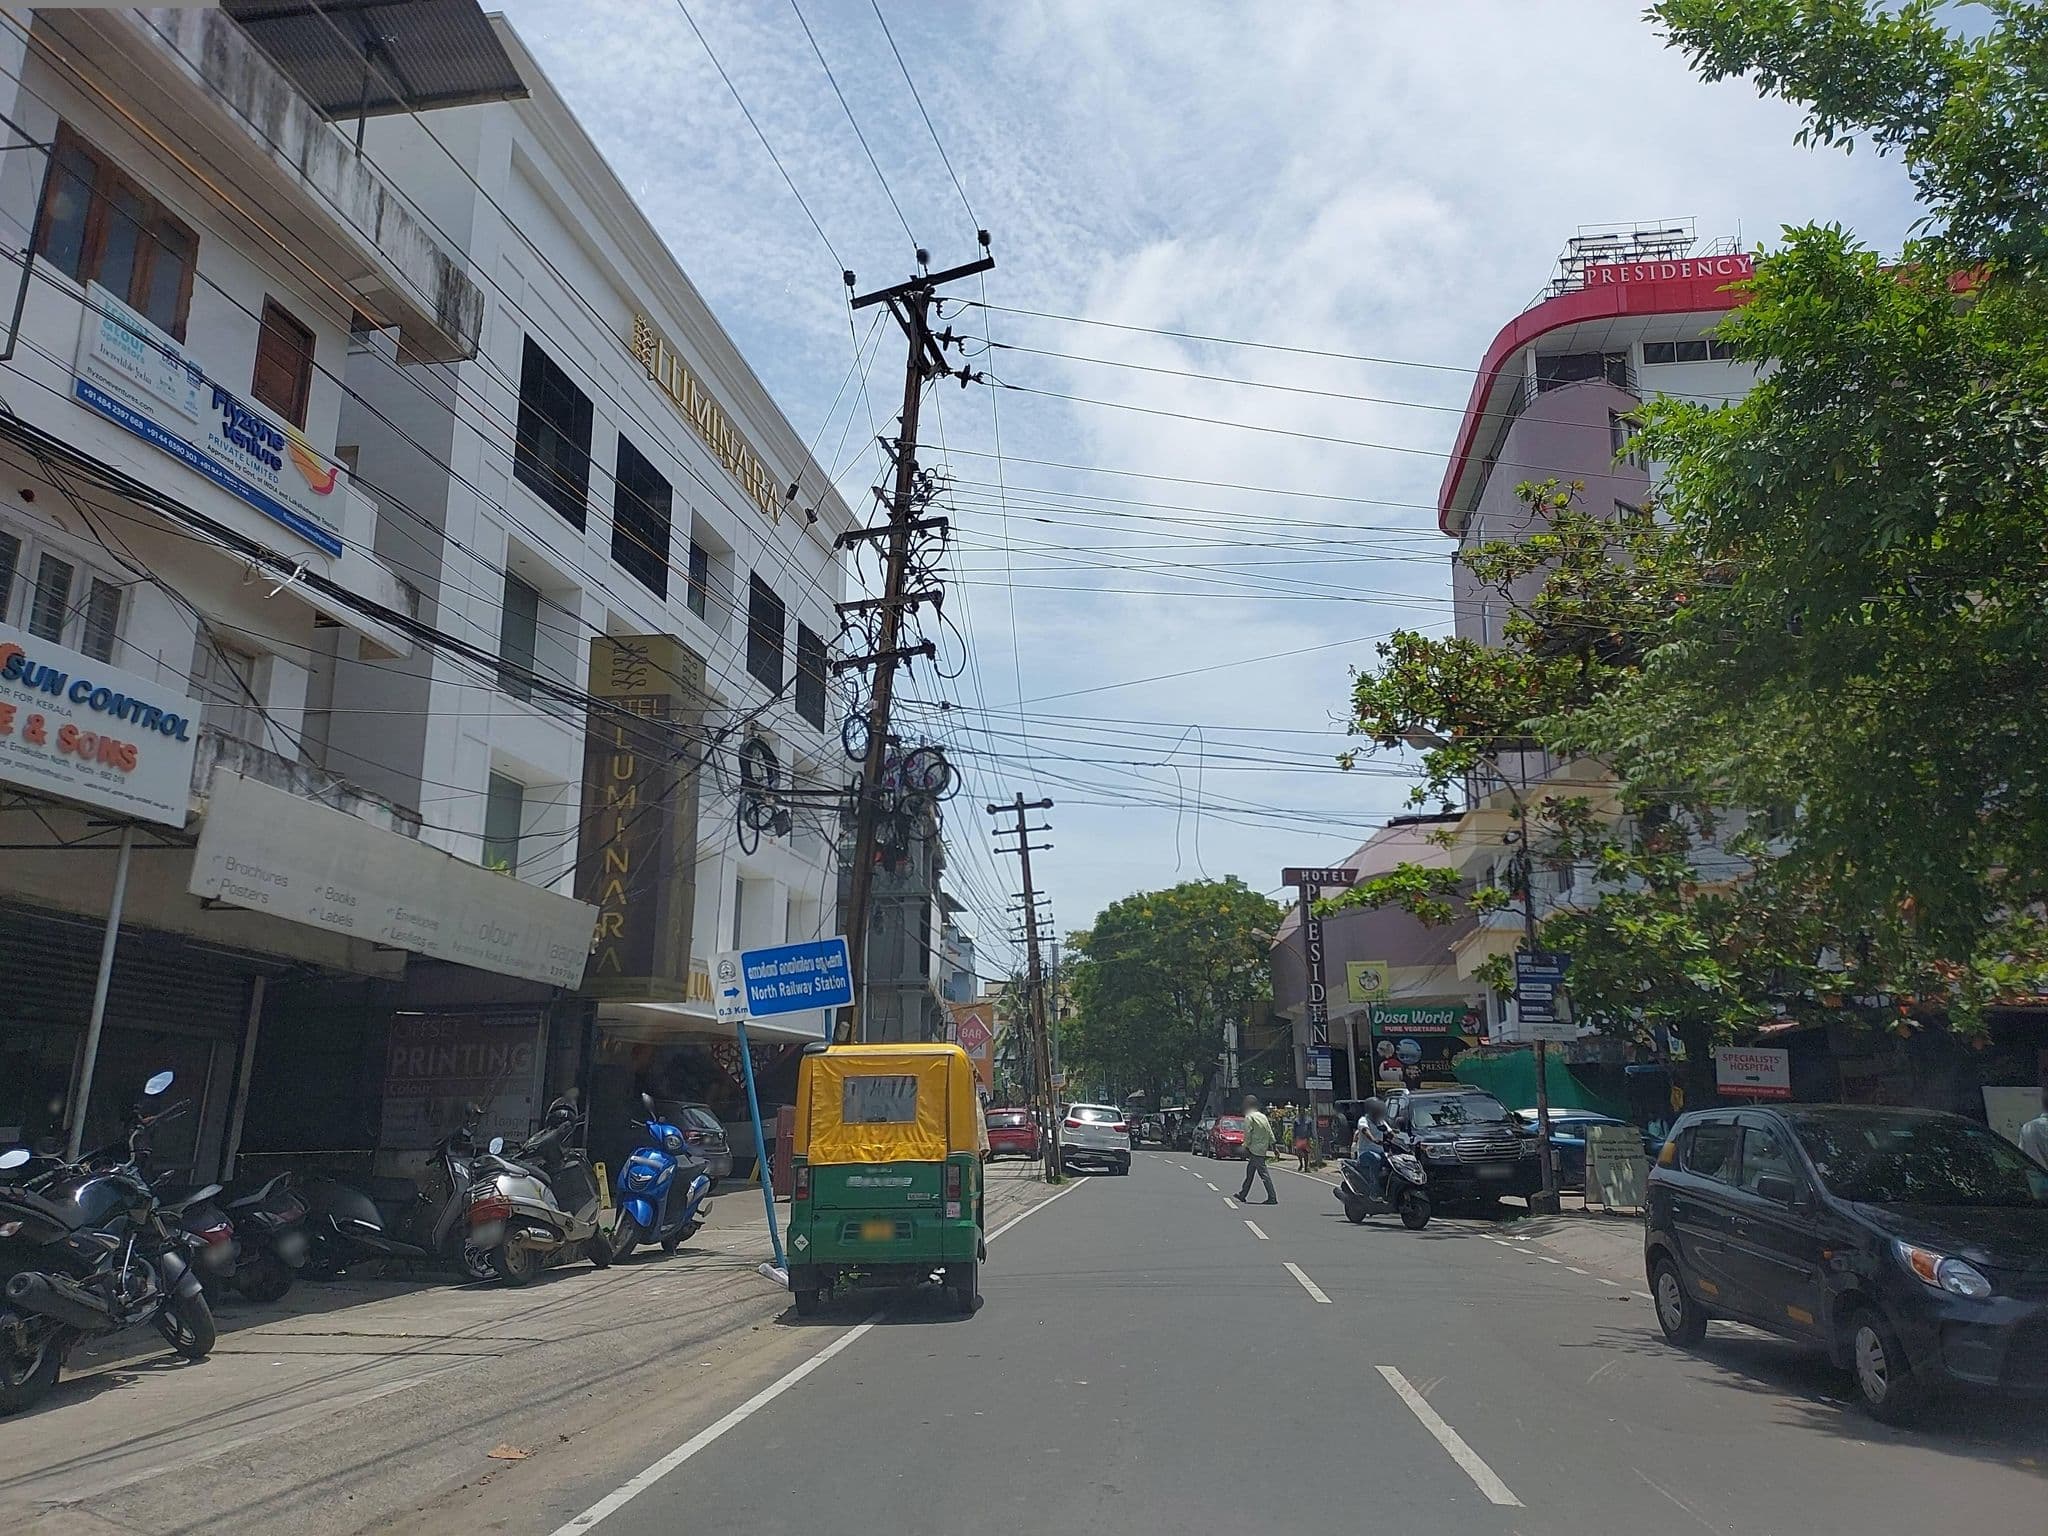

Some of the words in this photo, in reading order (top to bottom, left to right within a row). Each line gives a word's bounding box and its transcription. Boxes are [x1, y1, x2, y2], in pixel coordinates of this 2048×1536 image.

[1587, 258, 1750, 285] PRESIDENCY
[212, 386, 286, 452] Flyzone
[654, 338, 780, 527] LUMINARA
[206, 444, 234, 466] Approved
[208, 433, 244, 463] PRIVATE
[245, 459, 279, 484] LIMITED
[2, 652, 69, 696] SUN
[69, 680, 190, 742] CONTROL
[13, 691, 33, 704] FOR
[36, 699, 72, 718] KERALA
[23, 714, 48, 746] &
[57, 724, 138, 773] SONS
[225, 856, 289, 888] Brochures
[1301, 871, 1349, 882] HOTEL
[219, 878, 270, 904] Posters
[325, 886, 357, 907] Books
[319, 907, 354, 928] Labels
[751, 984, 777, 1001] North
[779, 980, 812, 997] Railway
[814, 975, 846, 992] Station
[719, 1008, 732, 1016] 0.3
[734, 1006, 748, 1014] Km
[1374, 1011, 1408, 1024] Dosa
[1411, 1010, 1454, 1024] World
[961, 1028, 981, 1039] BAR
[391, 1043, 531, 1075] PRINTING
[1730, 1063, 1776, 1072] HOSPITAL
